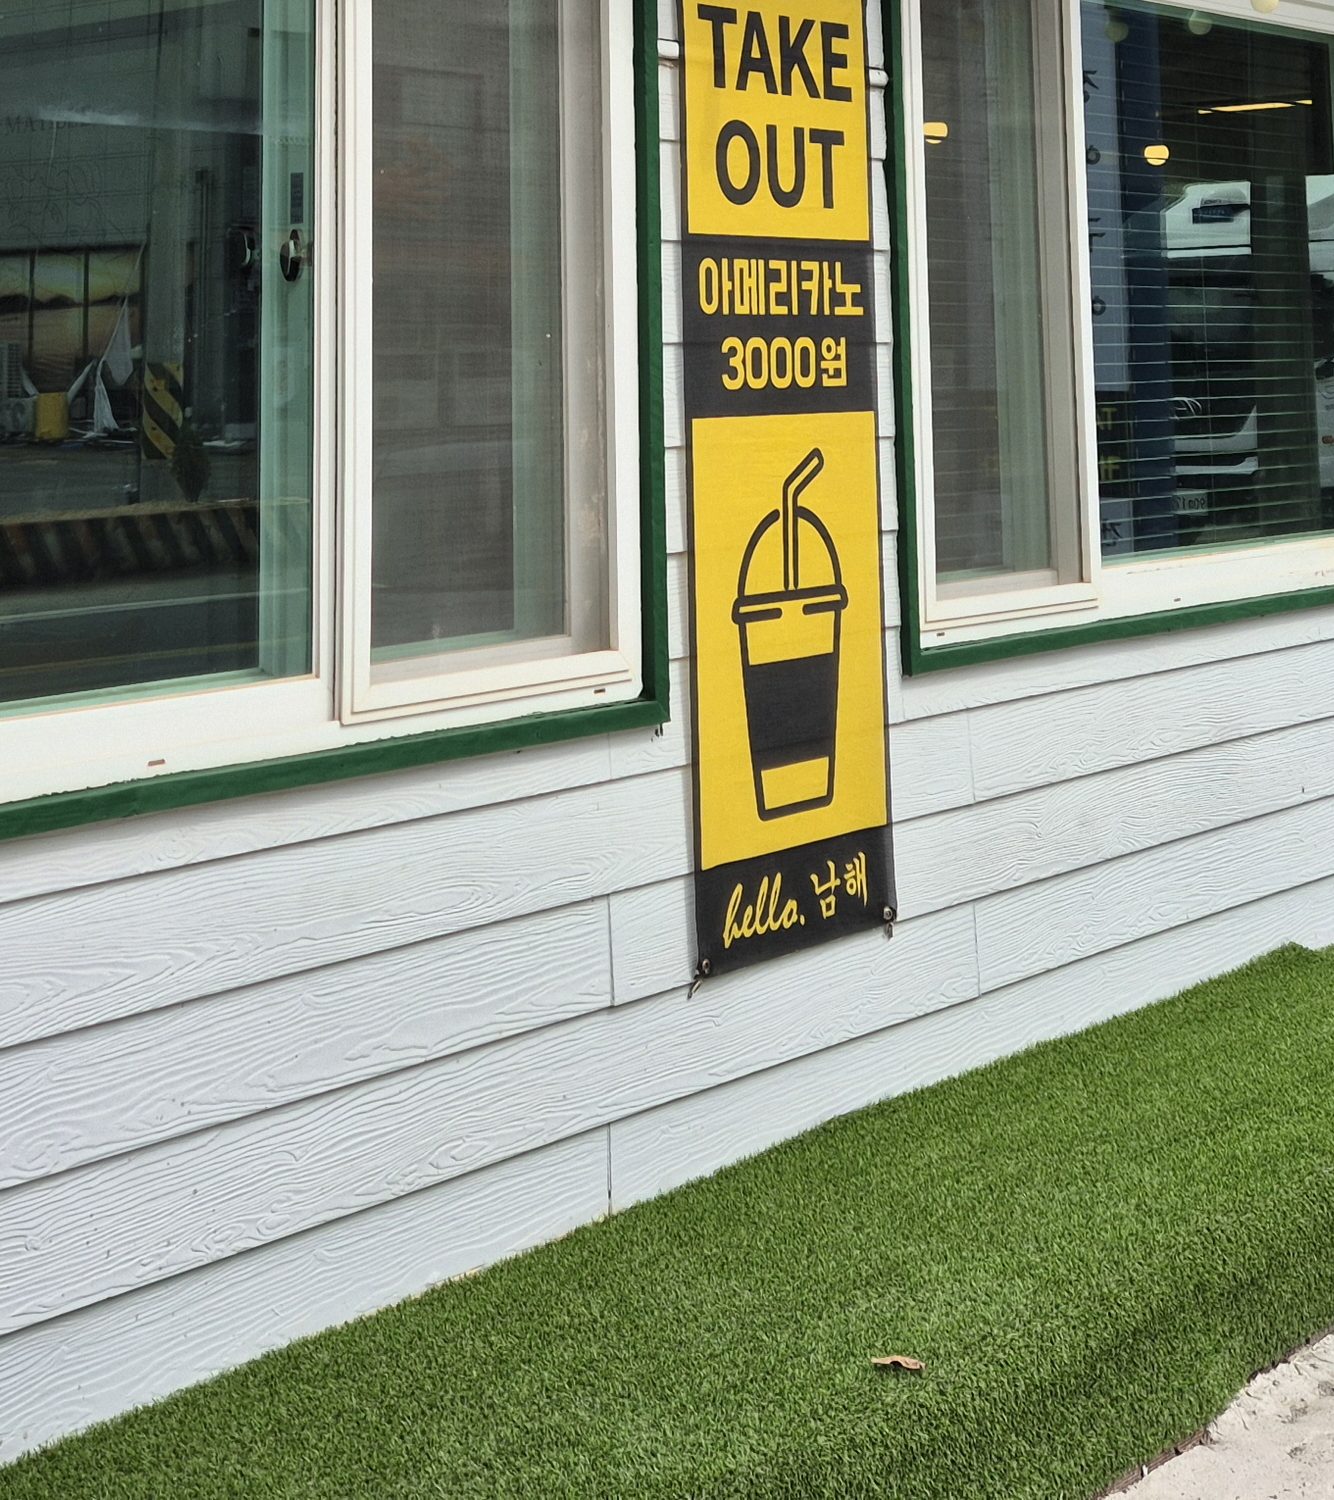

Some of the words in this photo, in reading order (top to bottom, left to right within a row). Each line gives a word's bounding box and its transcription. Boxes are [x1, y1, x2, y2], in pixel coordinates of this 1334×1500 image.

[697, 3, 853, 102] TAKE
[715, 119, 845, 209] OUT
[698, 257, 864, 317] 아메리카노
[721, 336, 849, 390] 3000원
[810, 851, 868, 920] 남해
